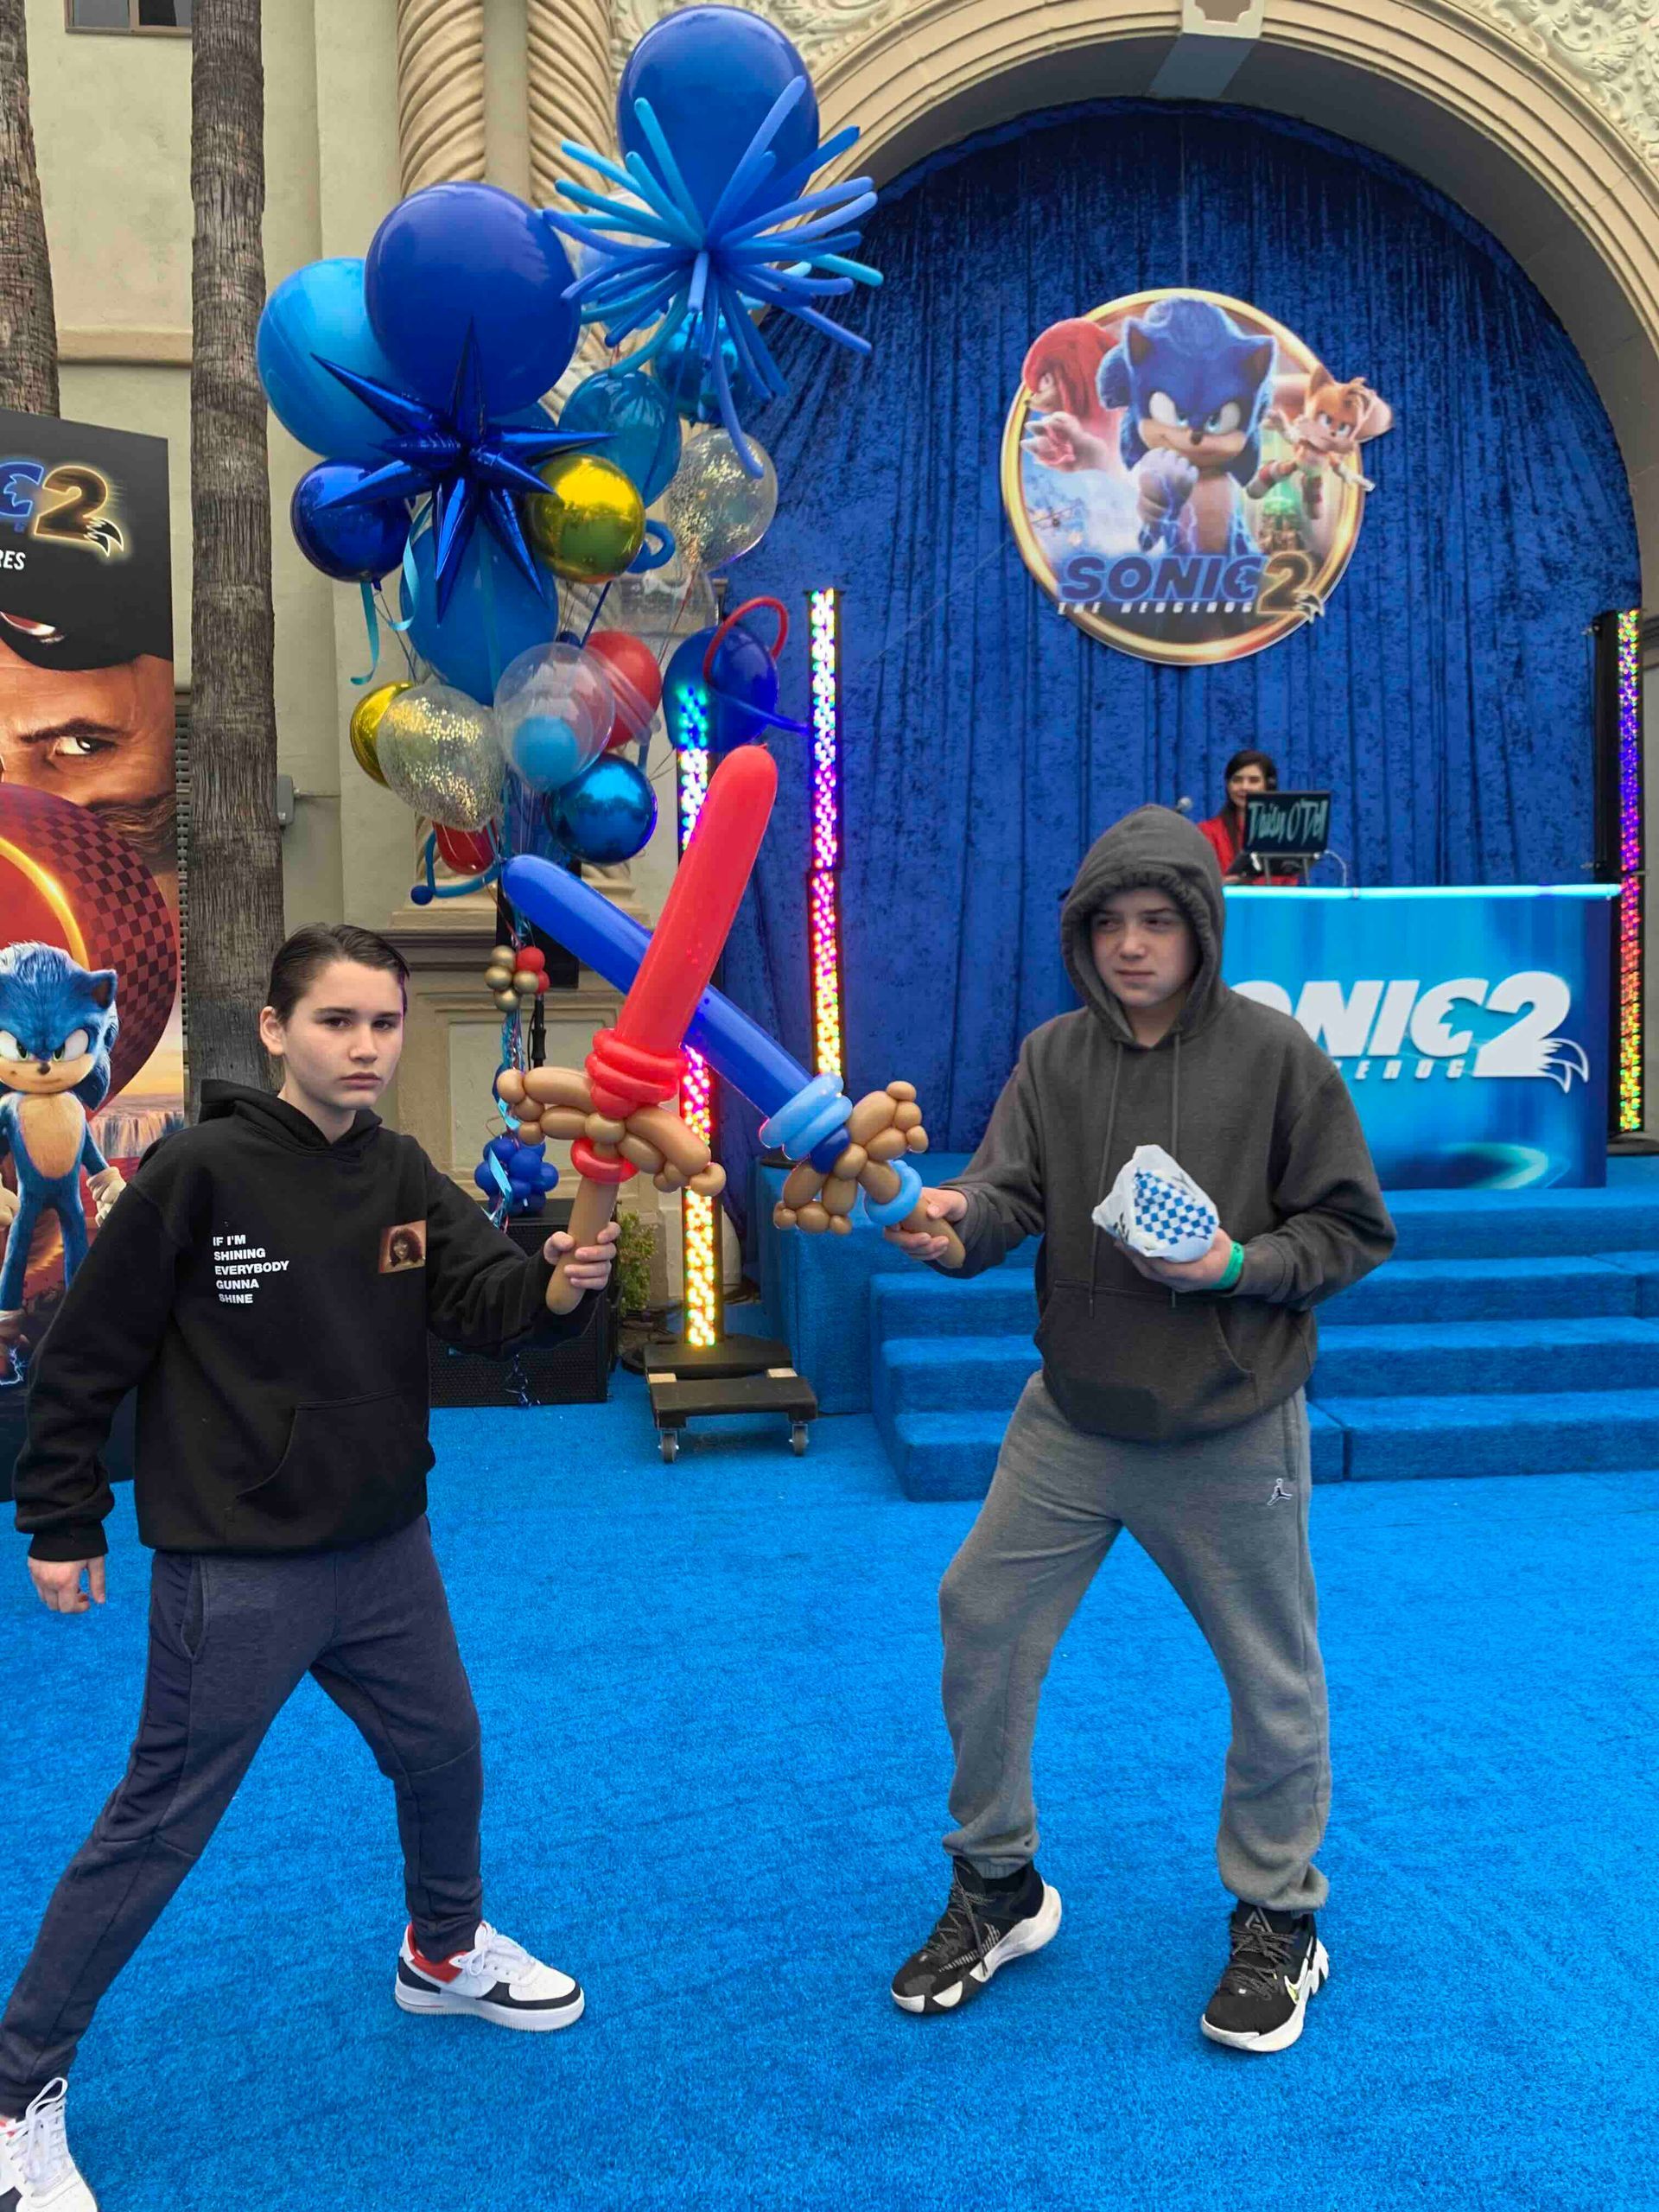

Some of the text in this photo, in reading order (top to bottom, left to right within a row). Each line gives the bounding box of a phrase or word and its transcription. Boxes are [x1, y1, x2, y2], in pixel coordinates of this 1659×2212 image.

[1059, 550, 1322, 620] SONIC 2
[1057, 601, 1254, 615] THE HEDGEHOG
[1472, 970, 1588, 1092] 2
[213, 1235, 246, 1246] IF I'M
[213, 1248, 266, 1260] SHINING
[214, 1261, 289, 1274] EVERYBODY
[216, 1279, 259, 1290] GUNNA
[219, 1294, 253, 1304] SHINE
